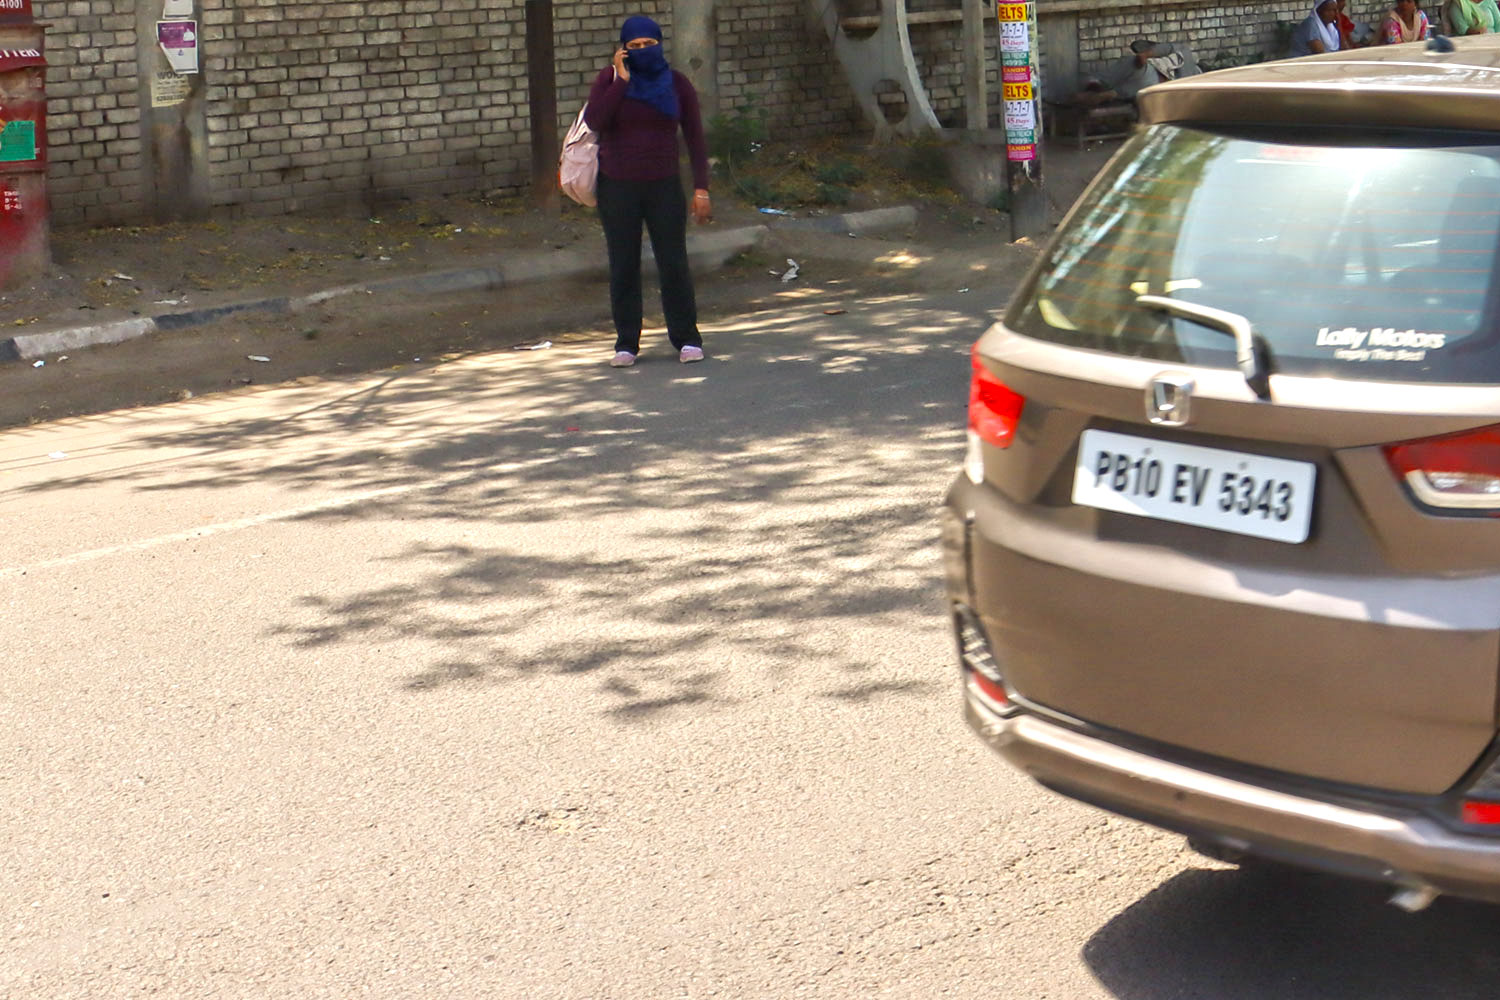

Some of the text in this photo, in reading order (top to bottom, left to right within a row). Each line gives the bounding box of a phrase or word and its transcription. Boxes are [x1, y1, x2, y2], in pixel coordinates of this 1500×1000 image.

[1368, 327, 1446, 349] Motors
[1094, 450, 1294, 522] PB10 EV 5343
